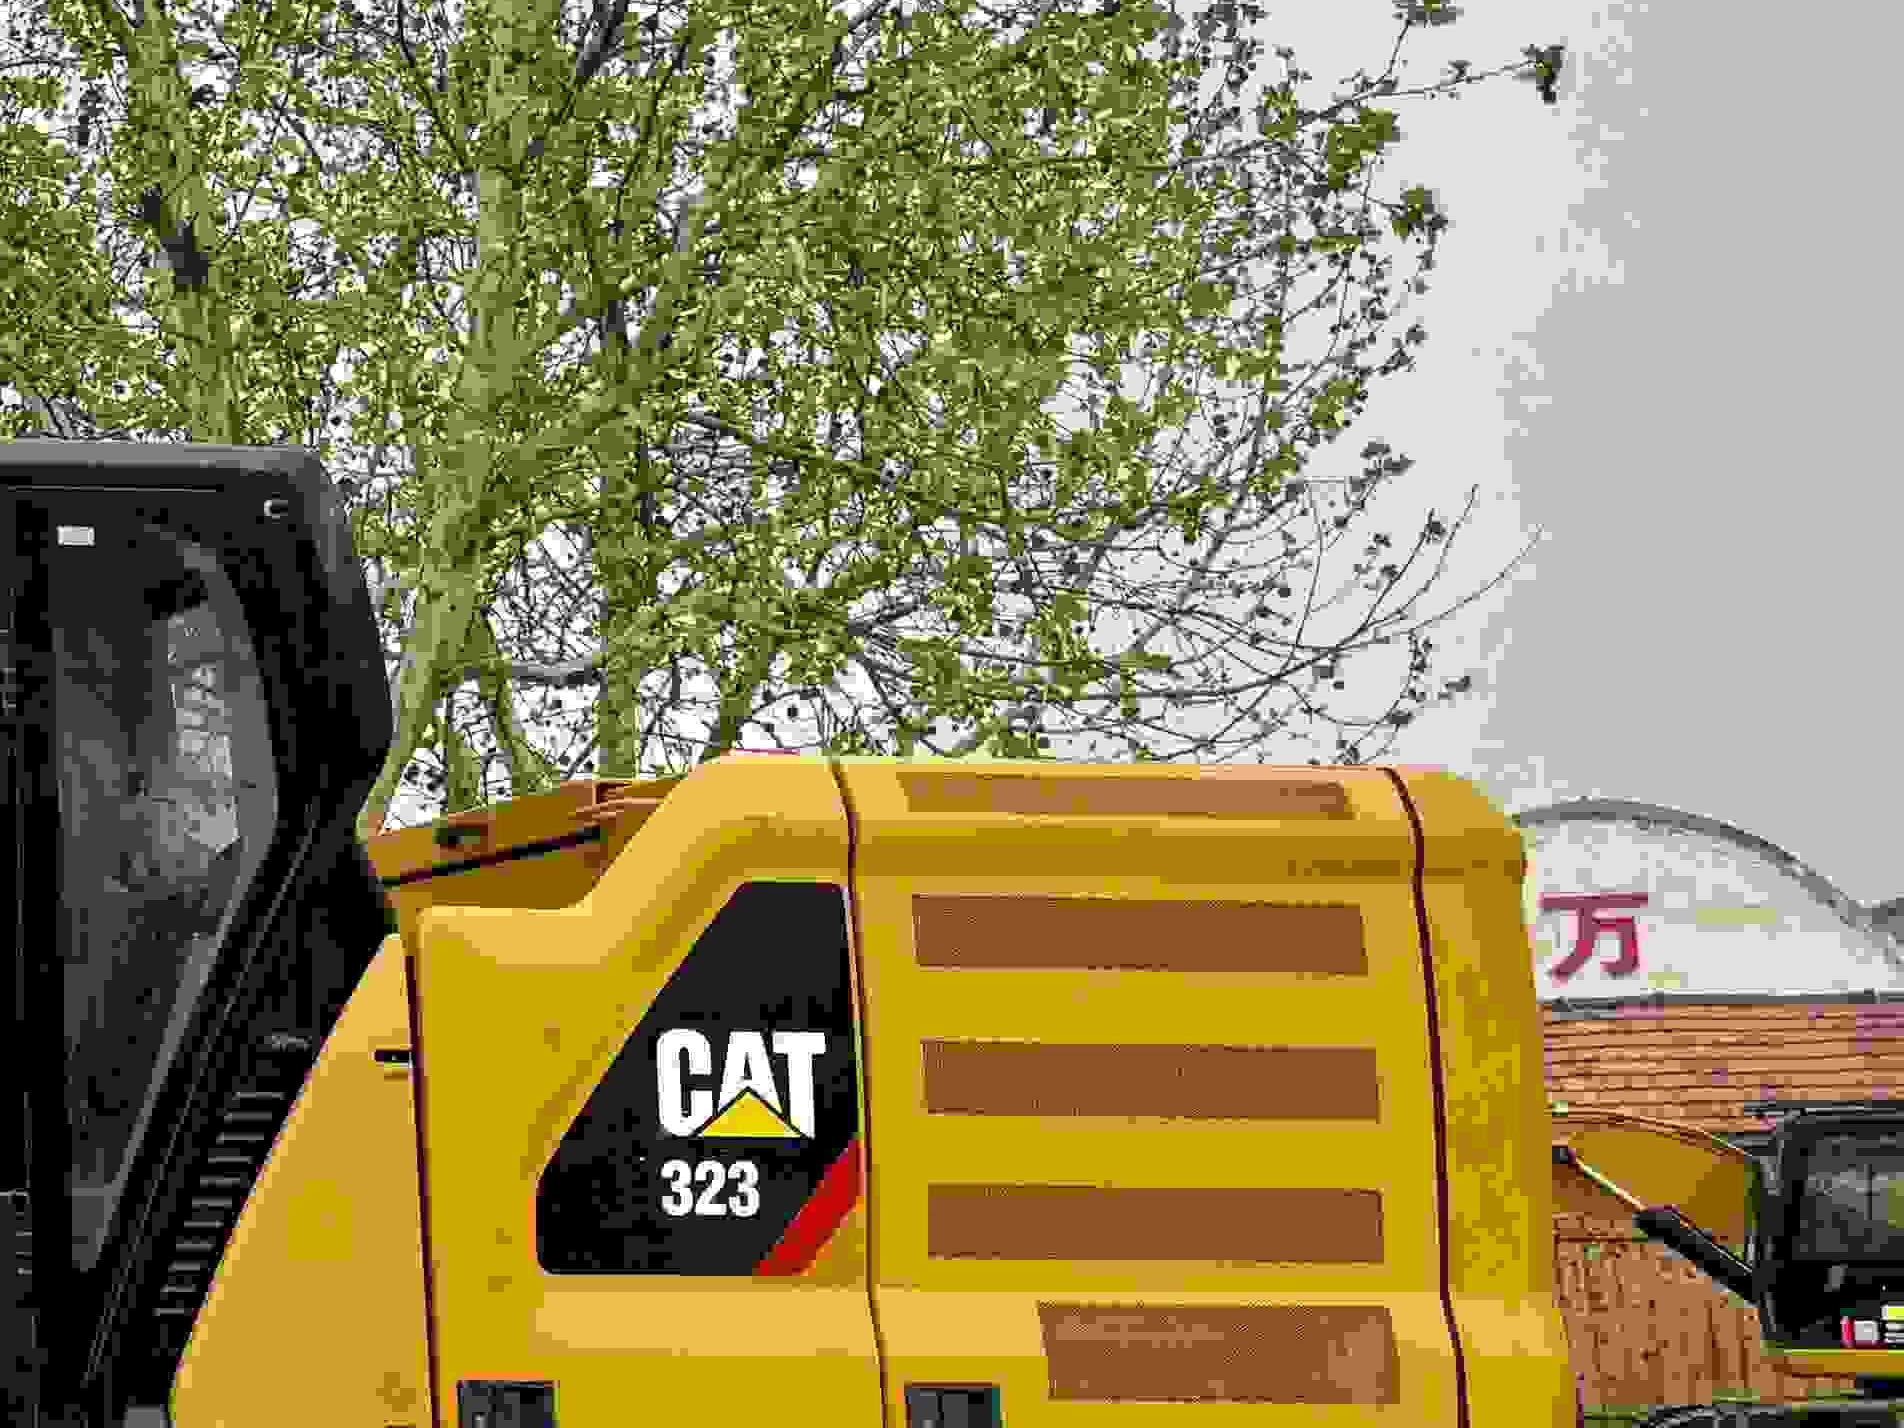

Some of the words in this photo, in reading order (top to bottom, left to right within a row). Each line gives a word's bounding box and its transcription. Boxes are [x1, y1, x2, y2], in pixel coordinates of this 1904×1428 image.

[1538, 892, 1649, 983] 万
[655, 1027, 826, 1140] CAT
[659, 1159, 761, 1218] 323
